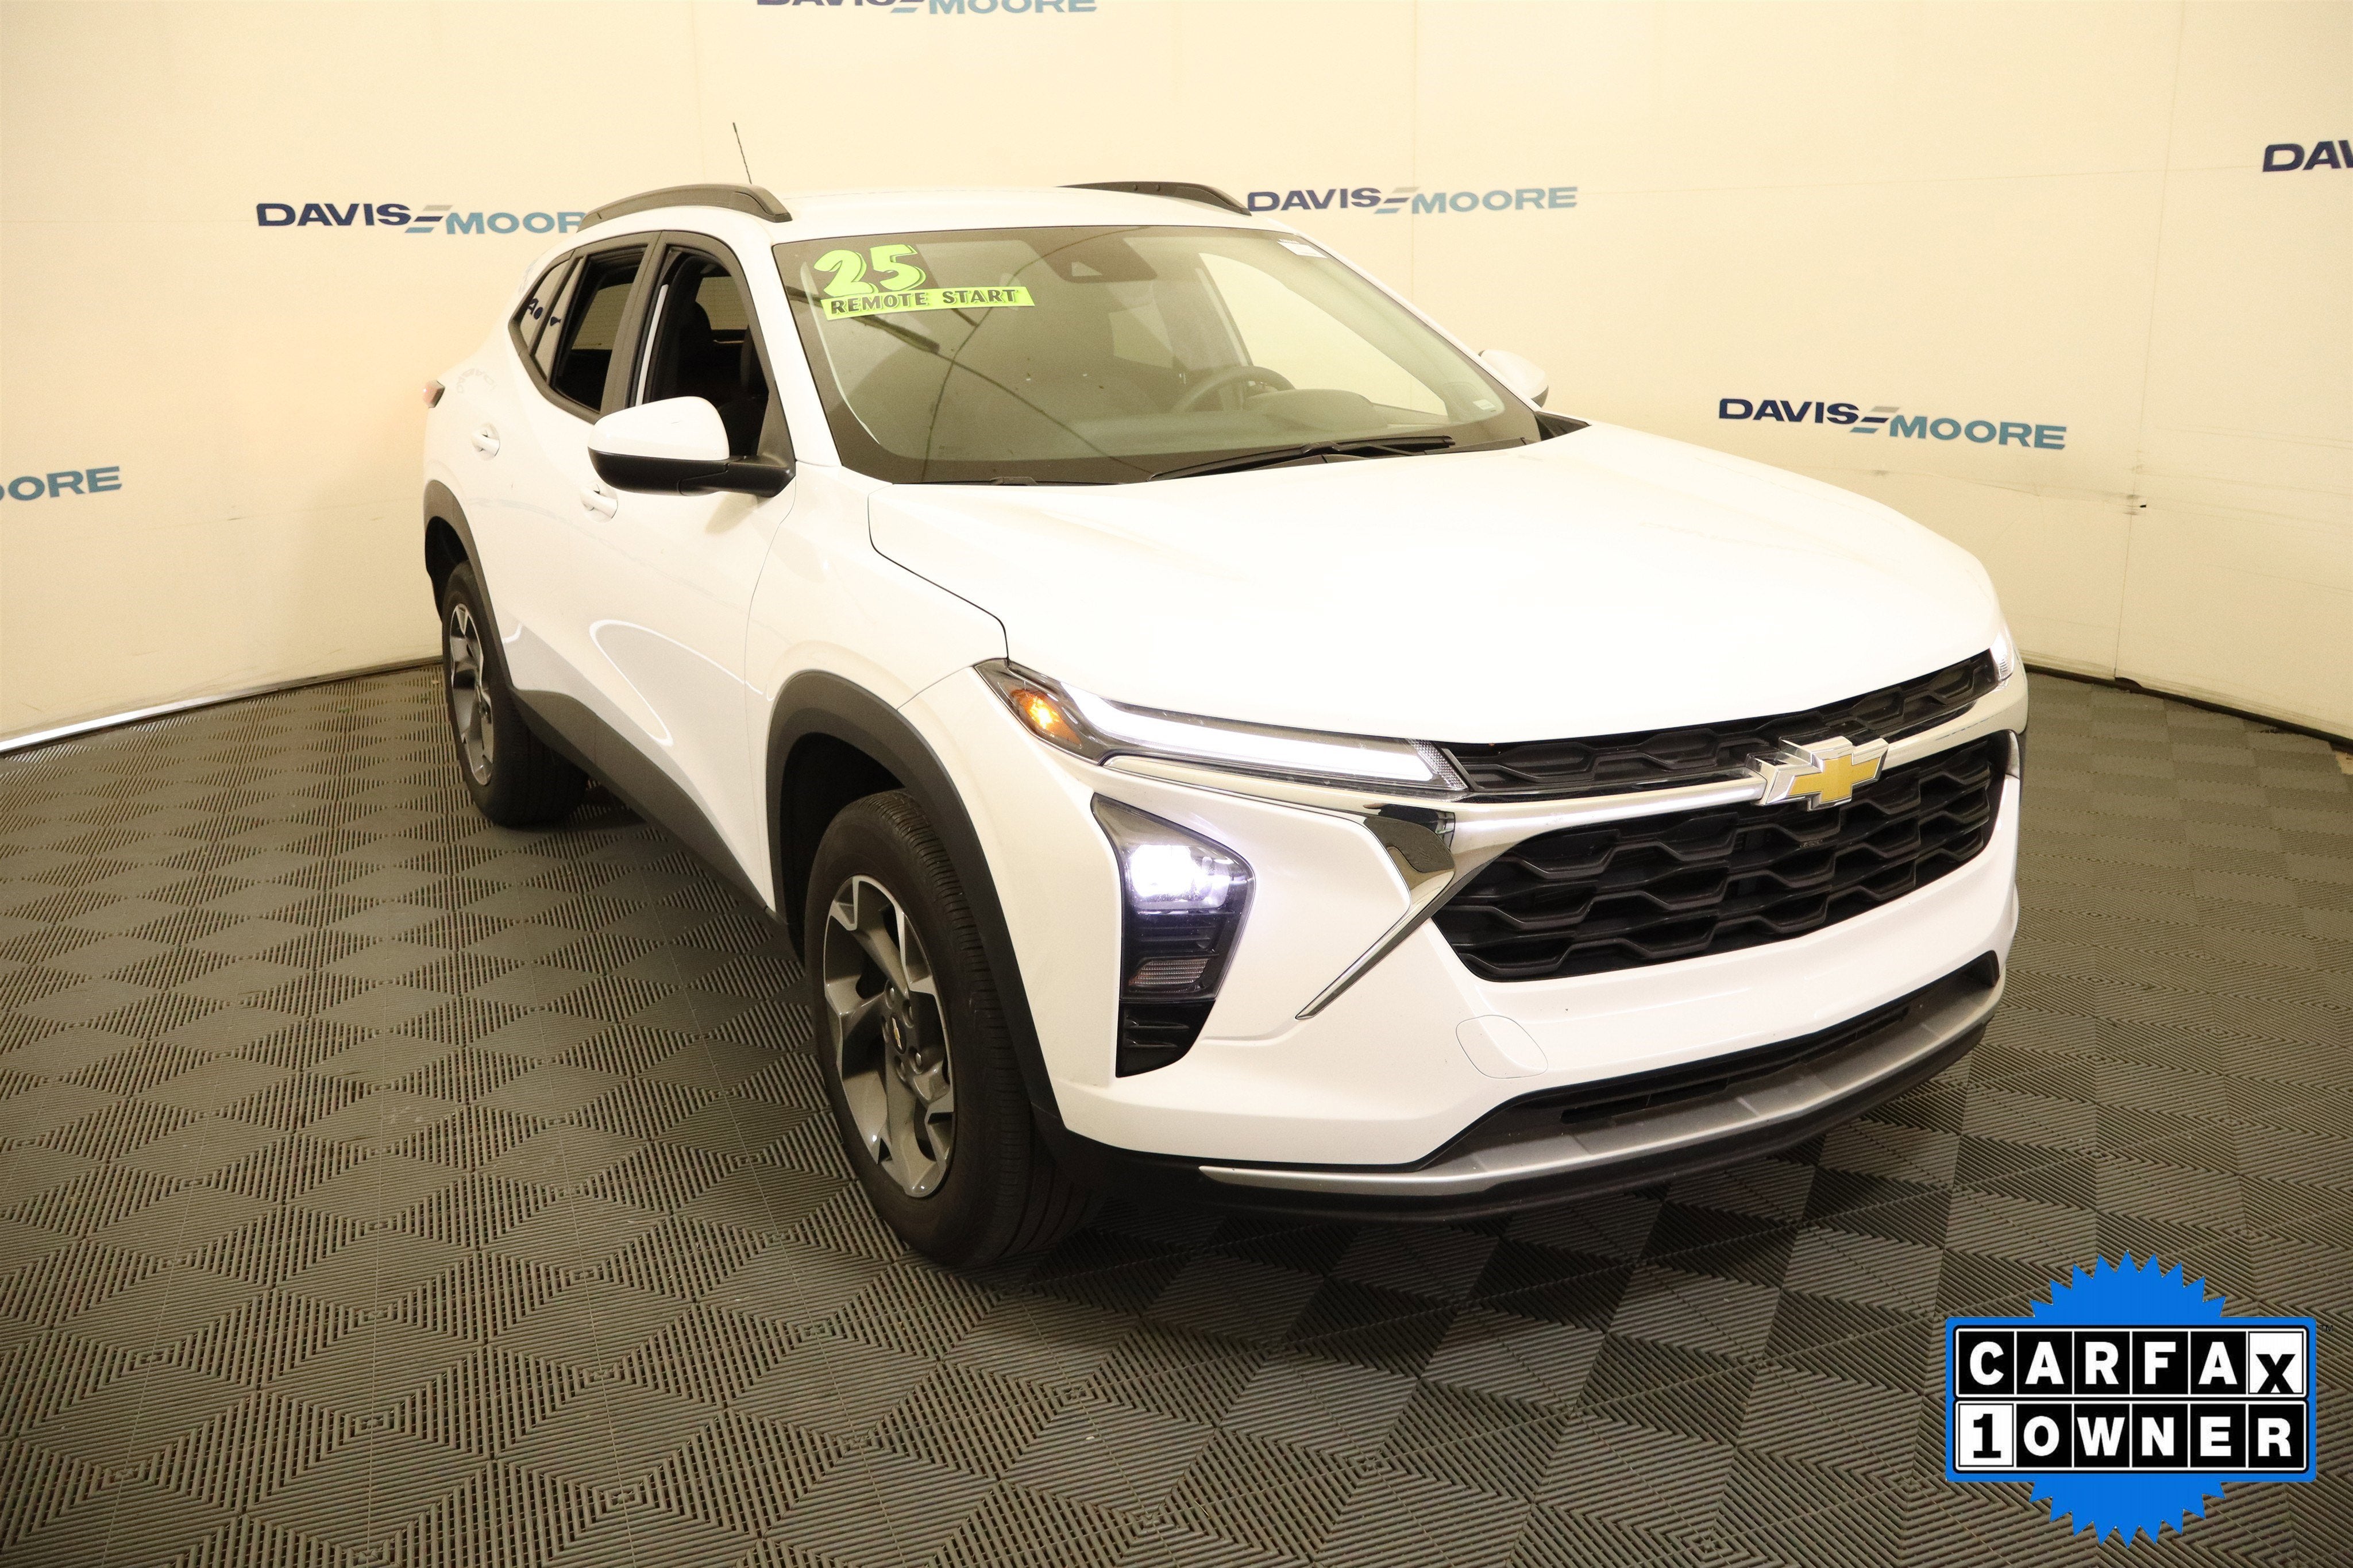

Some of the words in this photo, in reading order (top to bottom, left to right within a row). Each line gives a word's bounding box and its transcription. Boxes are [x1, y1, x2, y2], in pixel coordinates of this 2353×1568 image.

[256, 203, 411, 226] DAVIS
[1247, 187, 1382, 212] DAVIS
[1411, 186, 1577, 214] MOORE
[813, 244, 926, 297] 25
[831, 292, 928, 315] REMOTE
[942, 289, 1017, 305] START
[1719, 398, 1860, 425] DAVIS
[1889, 415, 2067, 450] MOORE
[0, 466, 122, 501] ORE
